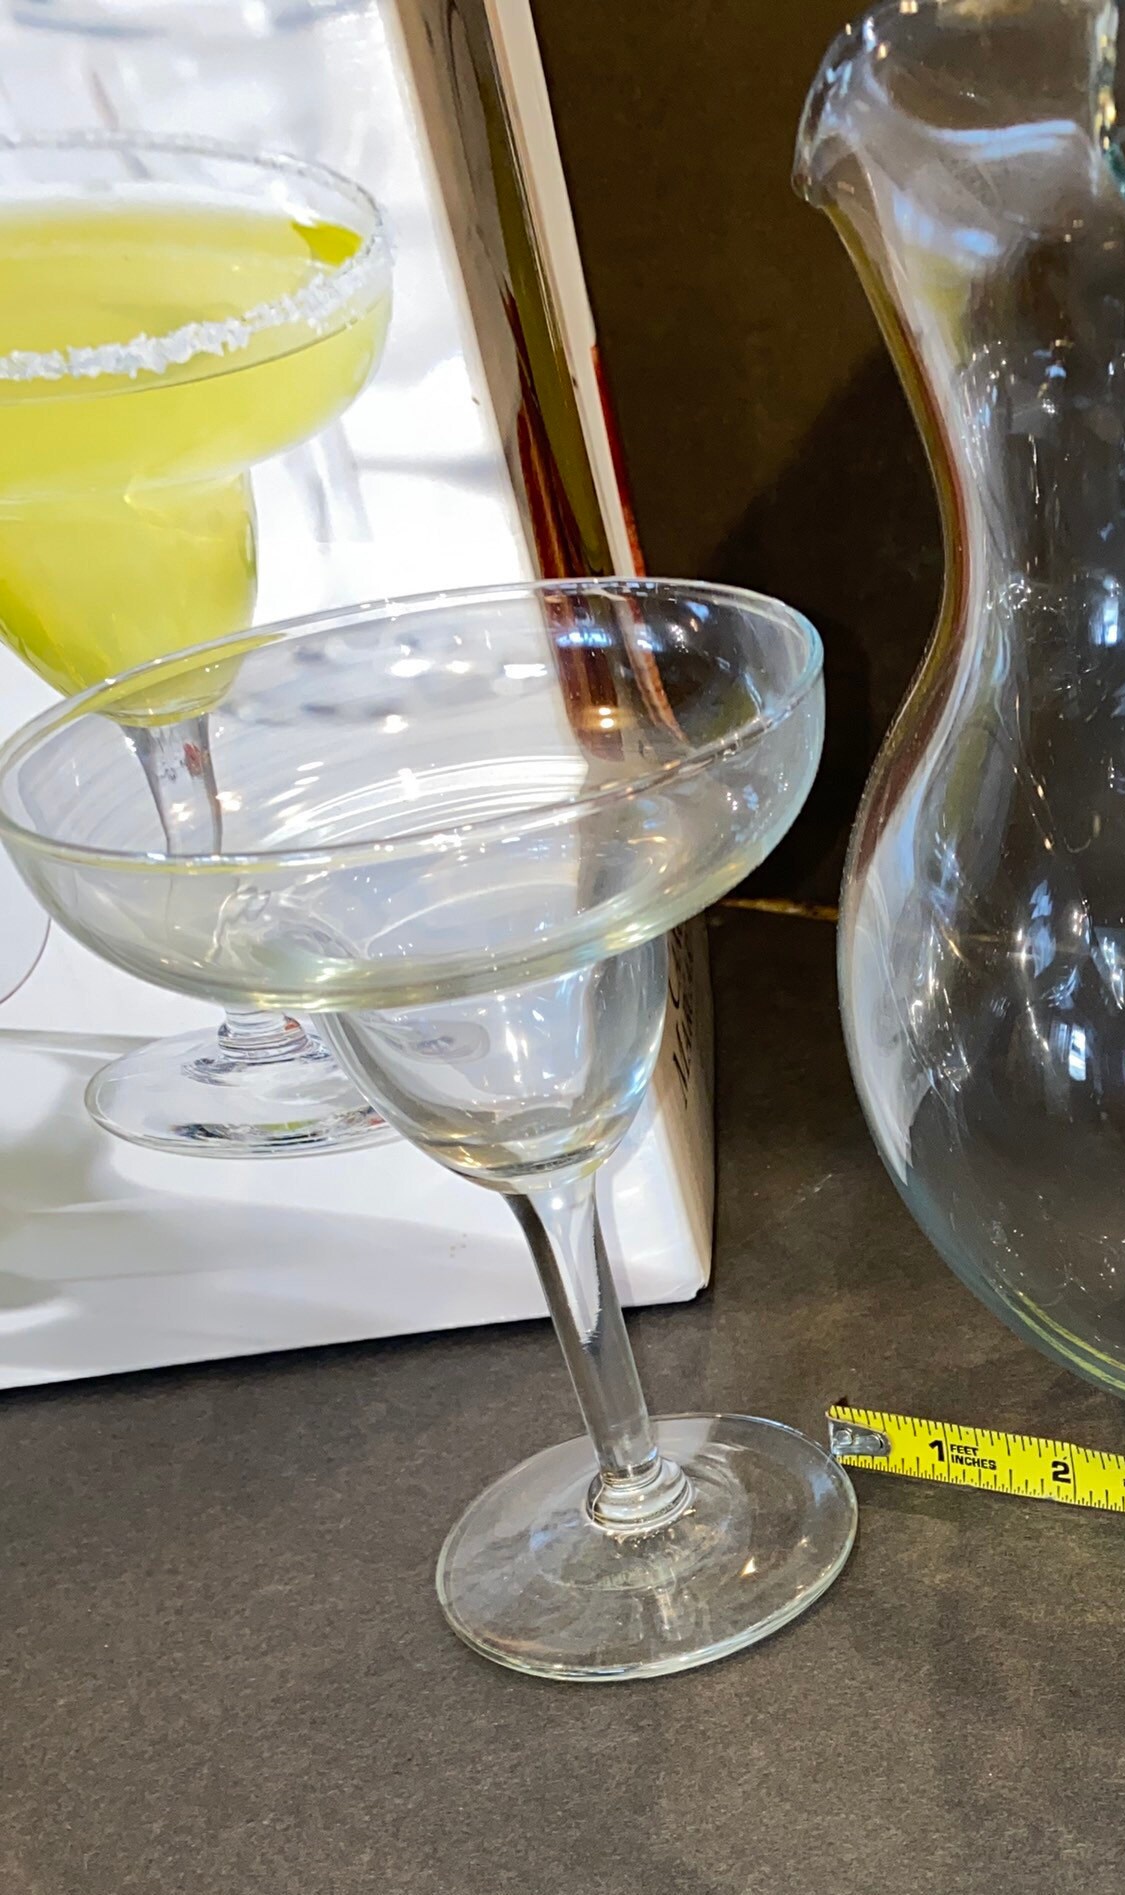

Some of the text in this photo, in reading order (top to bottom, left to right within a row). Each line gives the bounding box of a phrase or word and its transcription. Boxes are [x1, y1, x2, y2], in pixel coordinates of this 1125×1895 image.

[929, 1440, 945, 1462] 1
[950, 1444, 979, 1456] FEET
[951, 1454, 997, 1470] INCHES
[1051, 1461, 1071, 1483] 2
